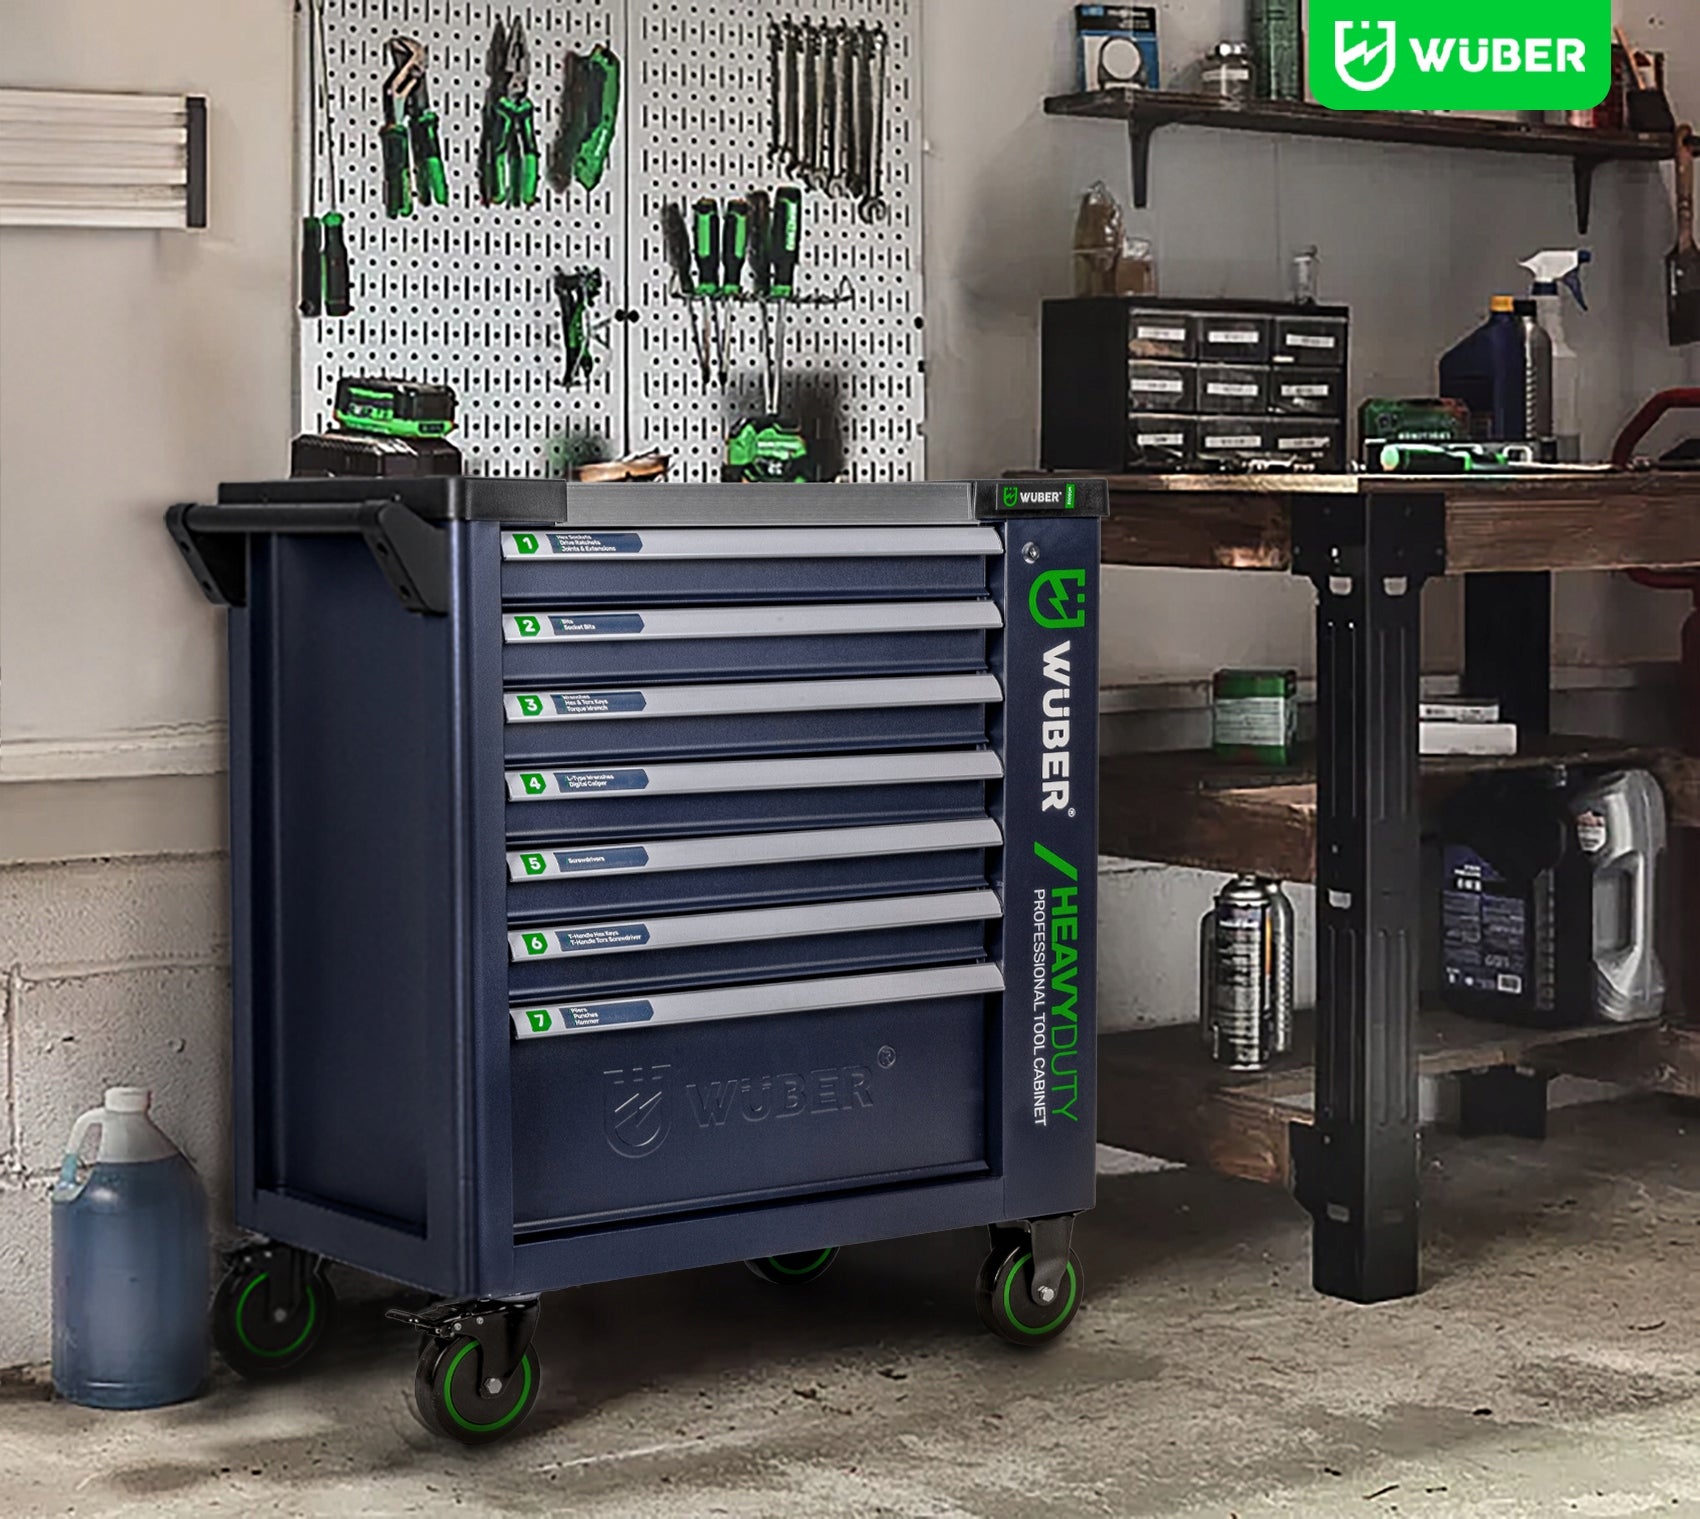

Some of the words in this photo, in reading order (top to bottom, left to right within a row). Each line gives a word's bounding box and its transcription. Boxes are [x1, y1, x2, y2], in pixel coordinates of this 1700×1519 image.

[522, 537, 533, 550] 1
[522, 619, 536, 632] 2
[524, 699, 538, 711] 3
[1041, 639, 1071, 813] WÜBER
[529, 777, 541, 790] 4
[528, 857, 541, 870] 5
[531, 936, 543, 950] 6
[1033, 888, 1046, 1012] PROFESSIONAL
[533, 1014, 544, 1027] 7
[1033, 1013, 1046, 1056] TOOL
[1033, 1057, 1046, 1127] CABINET
